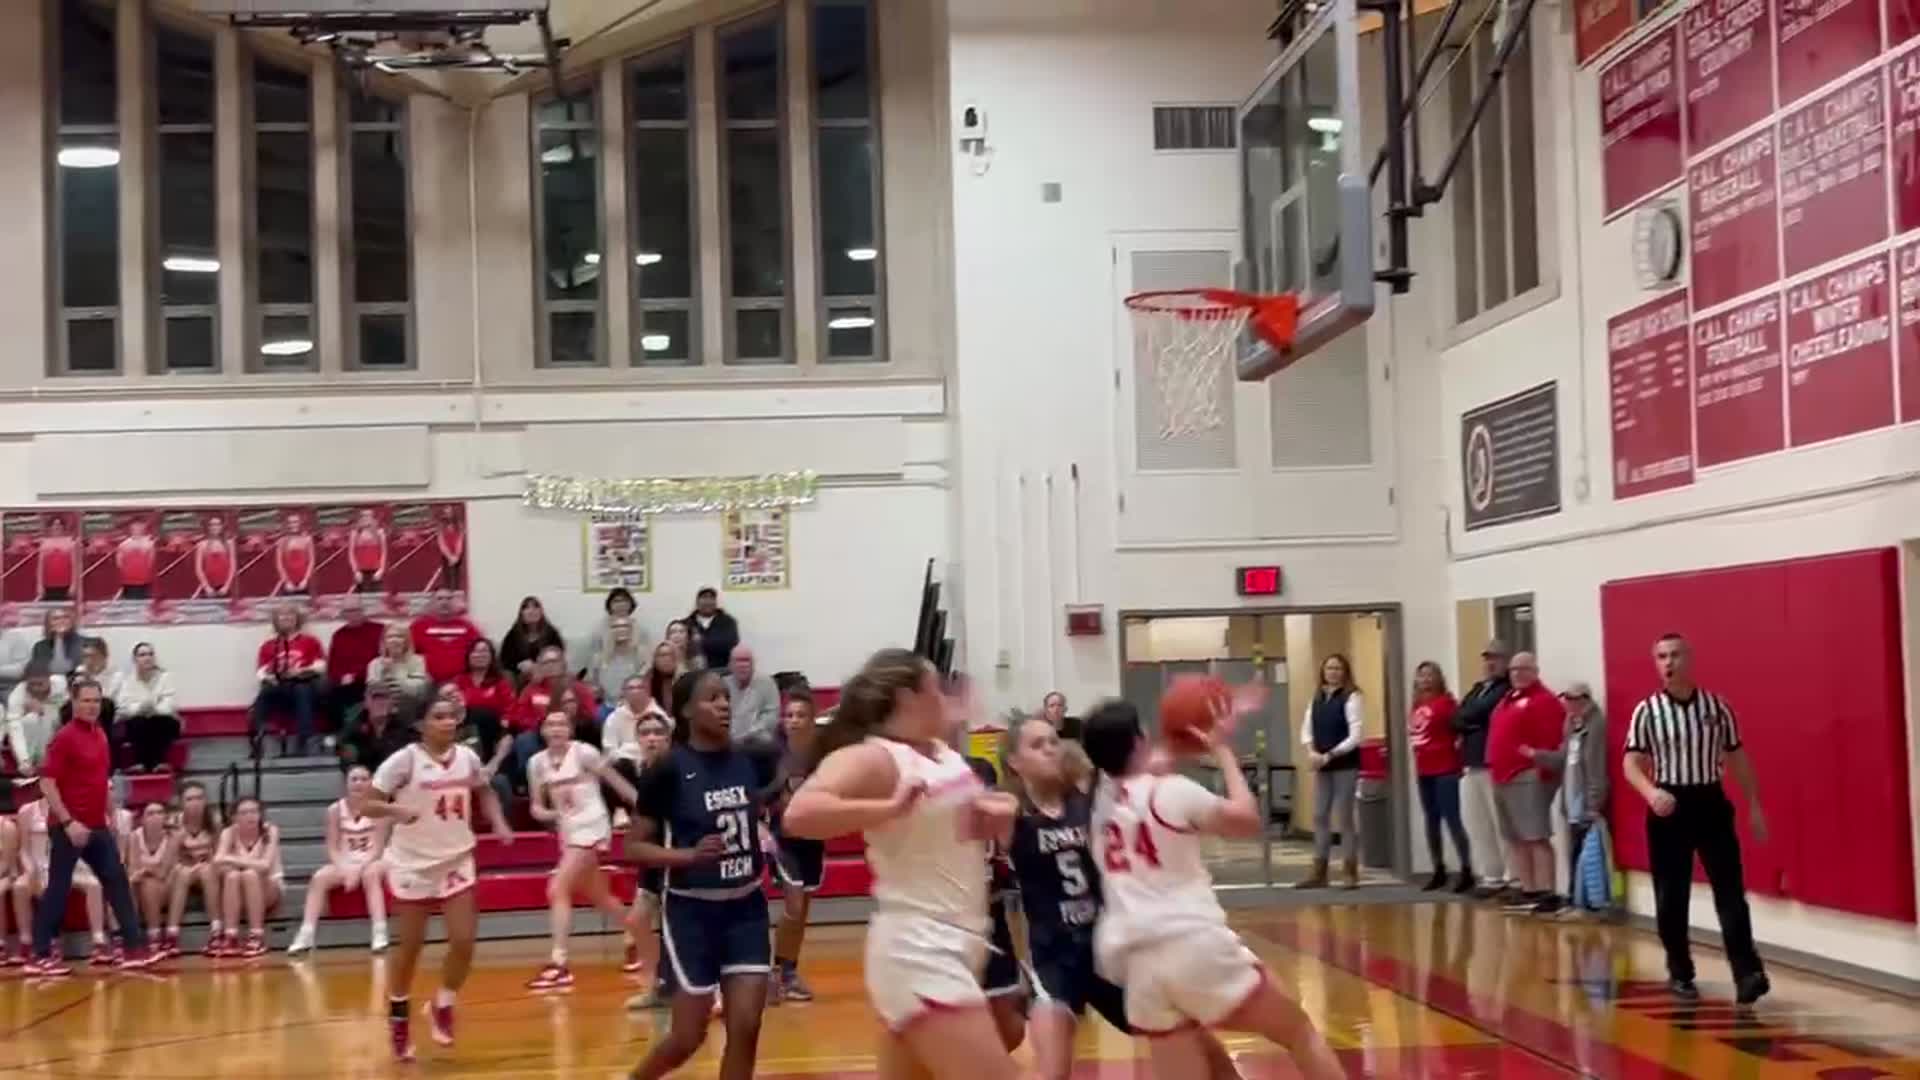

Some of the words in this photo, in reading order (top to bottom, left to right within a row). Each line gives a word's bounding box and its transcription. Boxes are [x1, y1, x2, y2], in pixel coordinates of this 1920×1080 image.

[1826, 260, 1886, 300] CHAMPS
[1727, 299, 1777, 337] CHAMPS
[1706, 329, 1768, 368] FOOTBALL
[1791, 315, 1889, 368] CHEERLEADING
[434, 795, 465, 821] 44
[716, 810, 751, 853] 21
[1103, 820, 1163, 874] 24
[719, 856, 753, 880] TECH
[1055, 850, 1089, 896] 5
